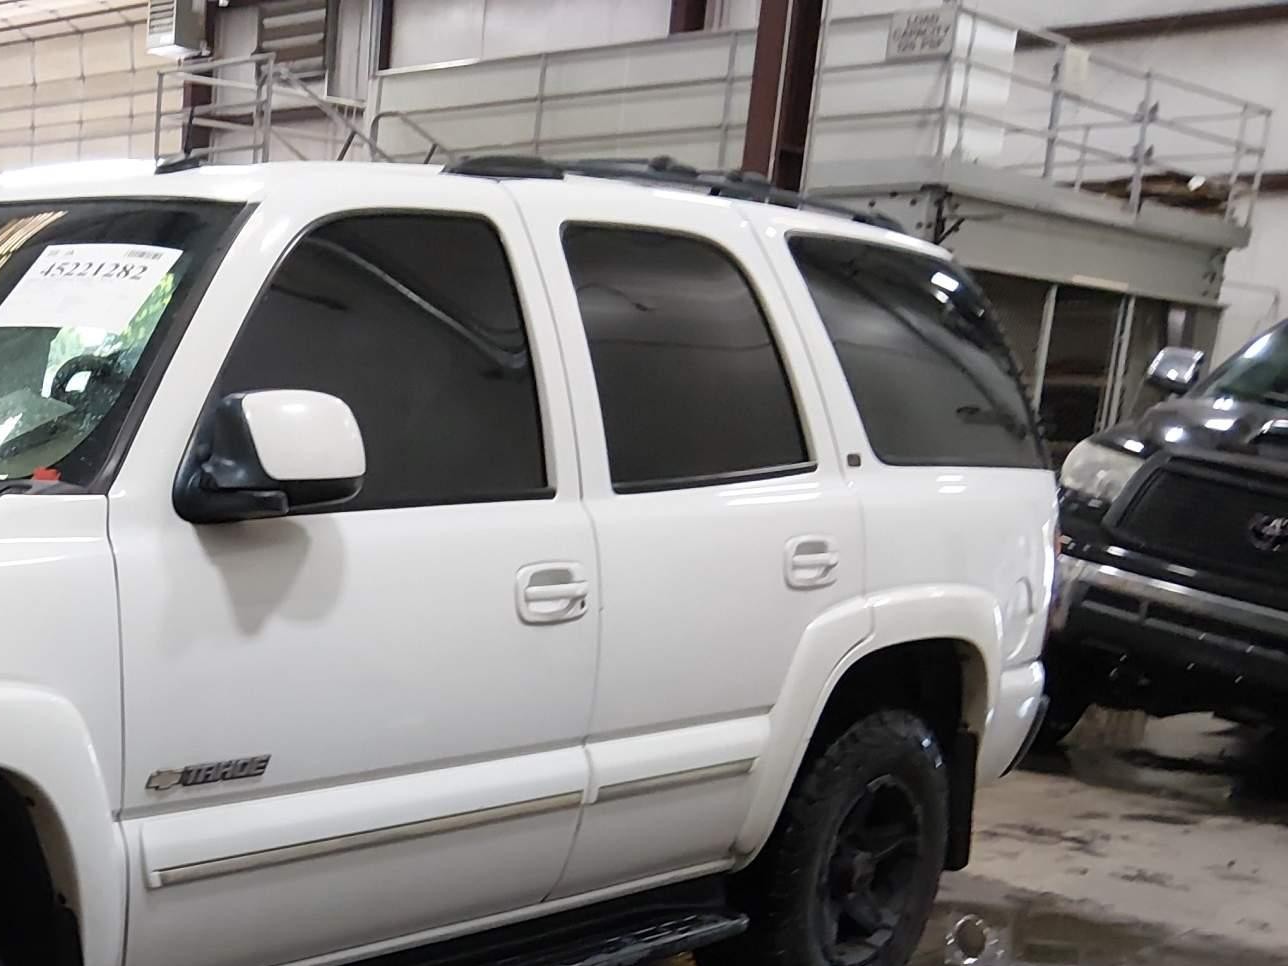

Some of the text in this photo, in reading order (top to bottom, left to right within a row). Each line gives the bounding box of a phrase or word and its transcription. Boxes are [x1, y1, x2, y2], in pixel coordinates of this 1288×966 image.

[893, 25, 951, 41] CAPACITY
[40, 262, 148, 281] 45221282
[182, 754, 271, 786] TAHOE
